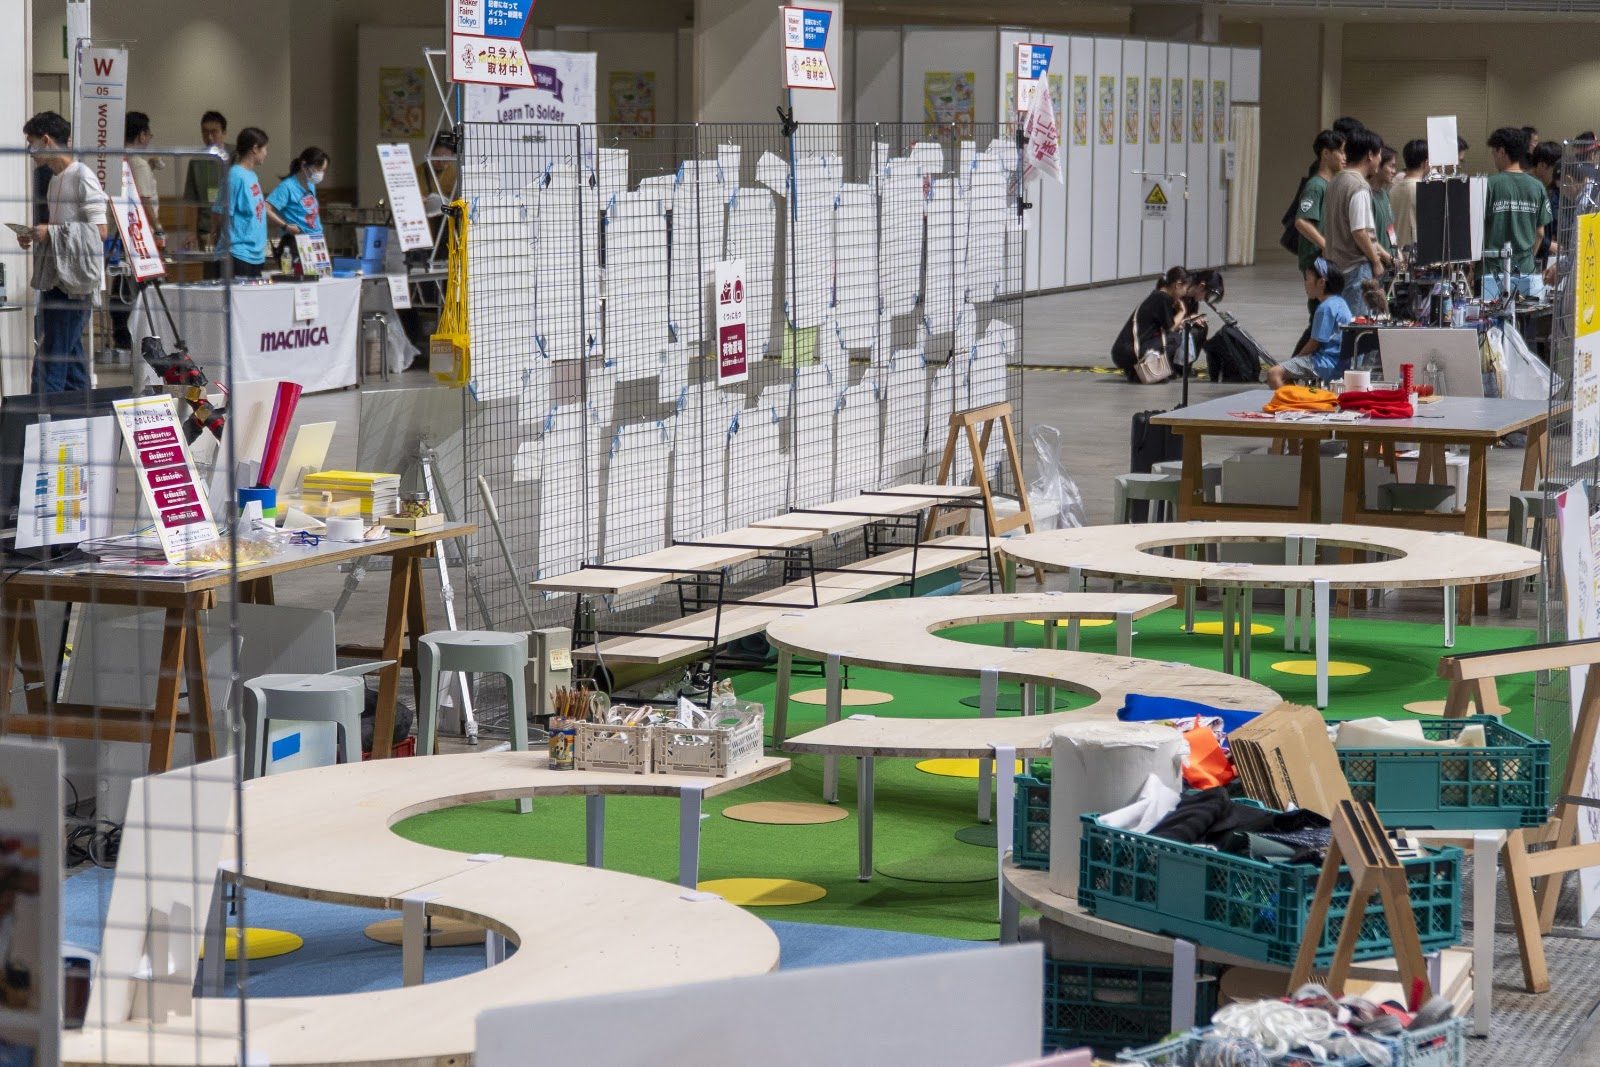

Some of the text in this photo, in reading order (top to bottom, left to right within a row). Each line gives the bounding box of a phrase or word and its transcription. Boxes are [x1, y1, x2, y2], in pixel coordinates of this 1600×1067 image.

[460, 7, 474, 15] Faire
[488, 9, 523, 19] メイカー新聞を
[459, 16, 477, 26] Tokyo
[94, 58, 114, 77] W
[96, 86, 109, 96] 05
[497, 103, 565, 123] Learn To Solder
